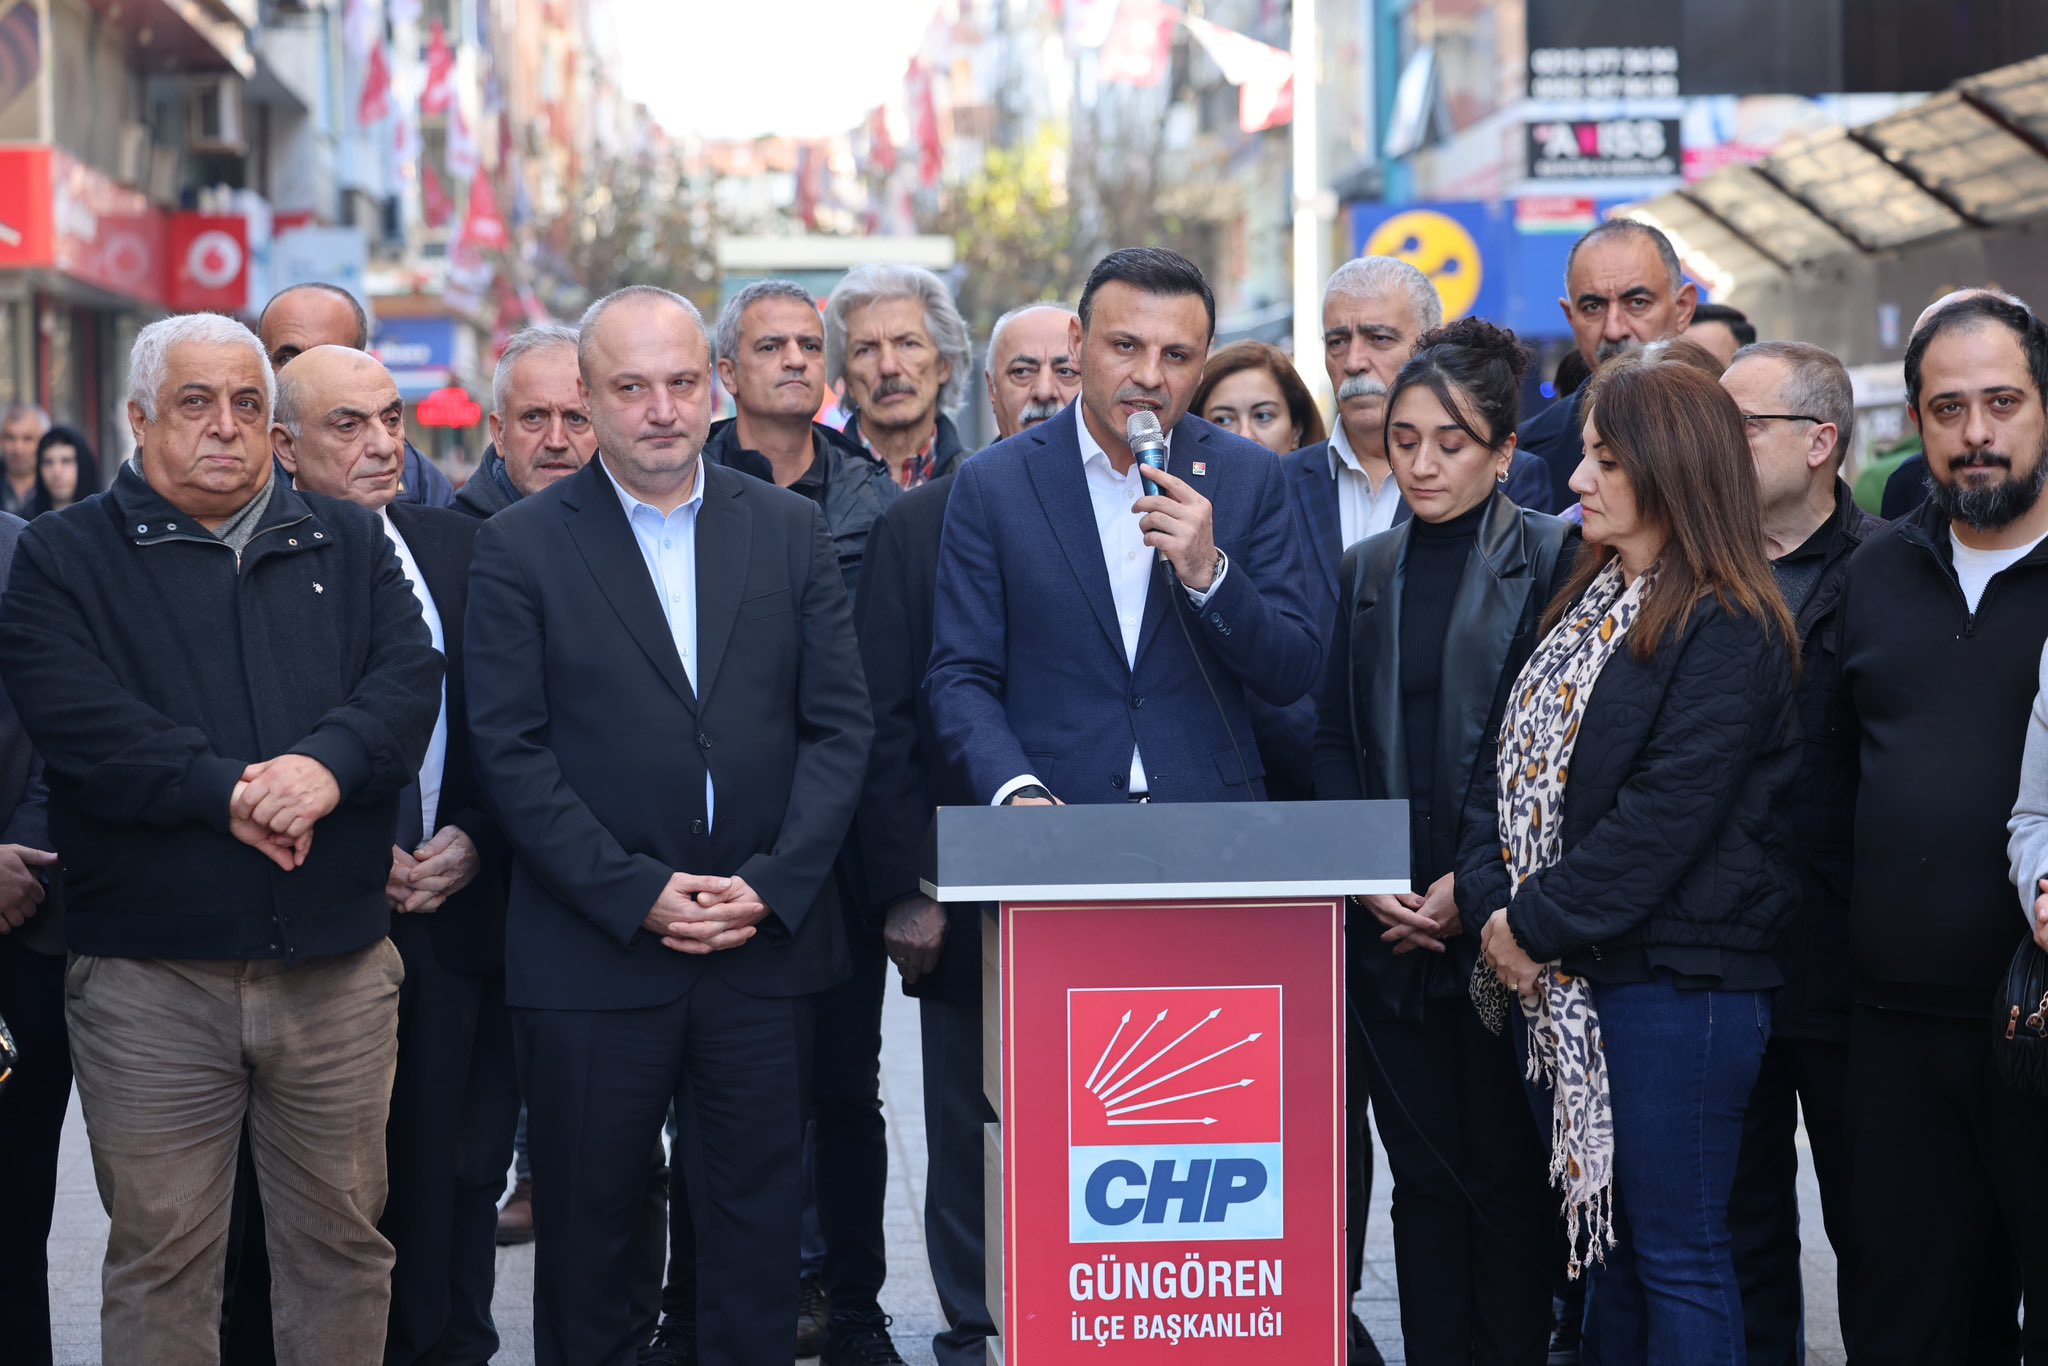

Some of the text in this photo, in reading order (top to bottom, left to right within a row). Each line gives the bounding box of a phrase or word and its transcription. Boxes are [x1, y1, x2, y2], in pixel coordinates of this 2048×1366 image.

[1085, 1158, 1268, 1226] CHP
[1069, 1253, 1282, 1301] GÜNGÖREN
[1072, 1306, 1282, 1347] İLÇE BAŞKANLIĞI
